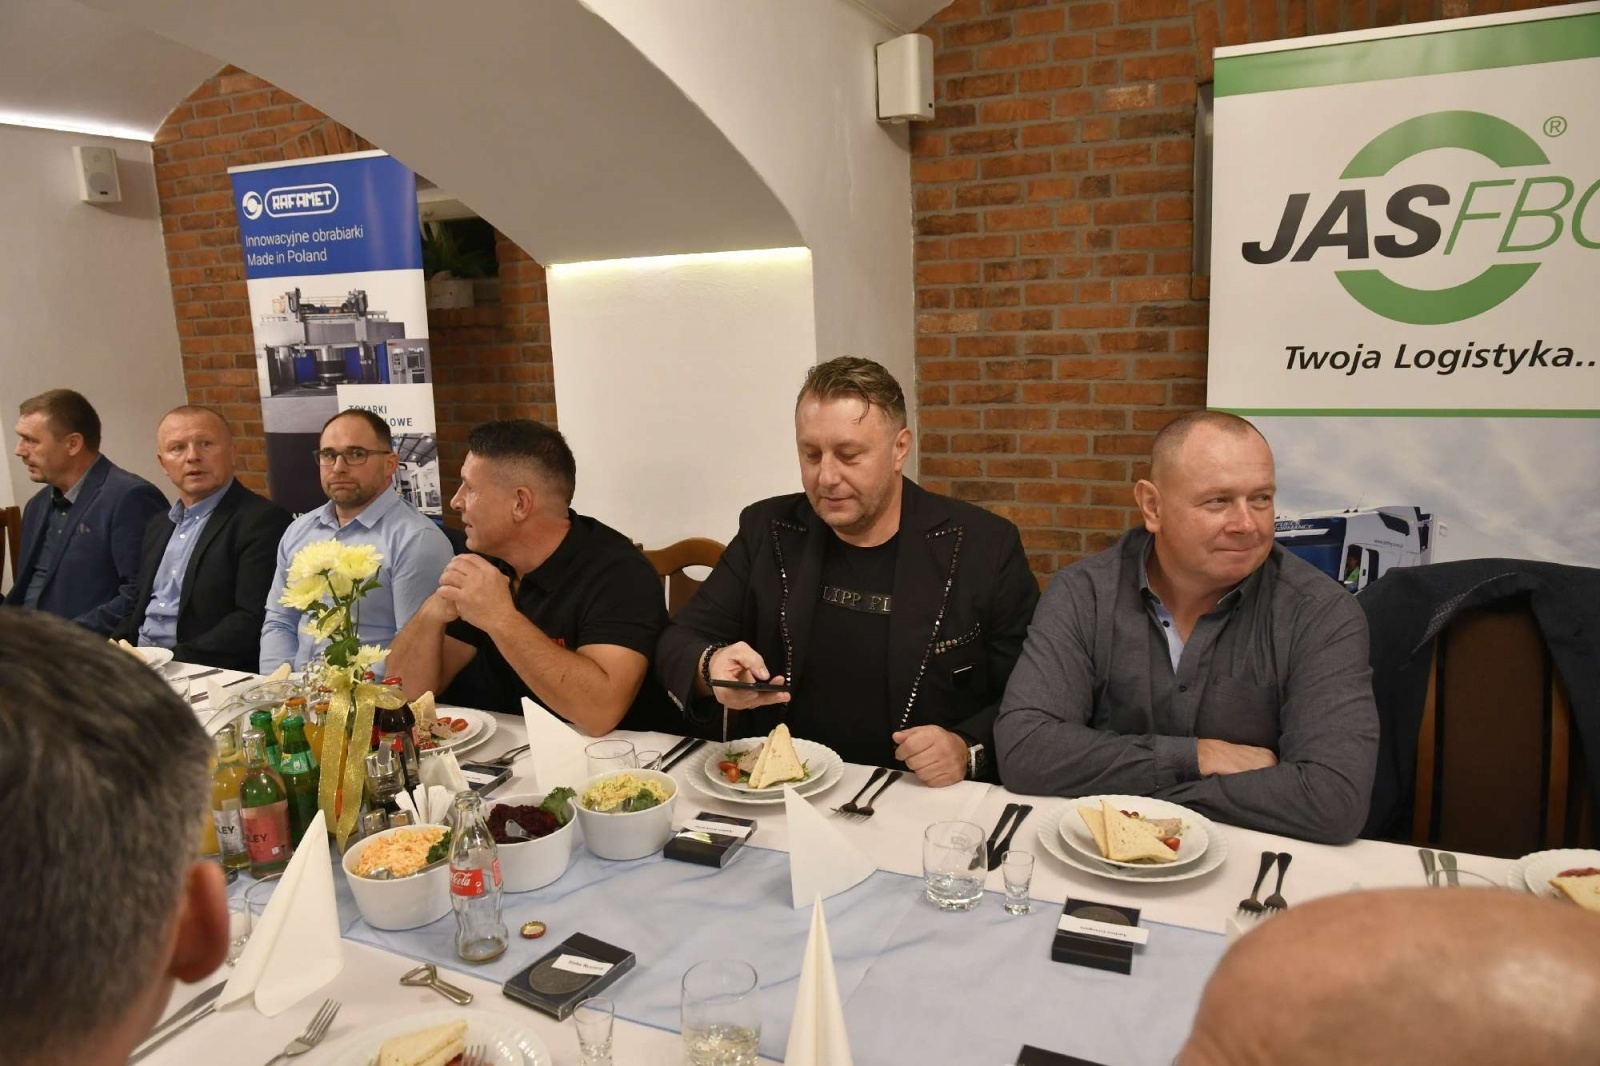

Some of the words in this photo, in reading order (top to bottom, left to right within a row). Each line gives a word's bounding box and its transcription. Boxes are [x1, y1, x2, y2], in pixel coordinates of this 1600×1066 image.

[272, 191, 331, 210] RAFAMET
[245, 231, 310, 248] Innowacyjne
[312, 224, 364, 242] obrabiarki
[247, 252, 275, 267] Made
[276, 252, 285, 264] in
[287, 248, 328, 263] Poland
[1285, 343, 1382, 376] Twoja
